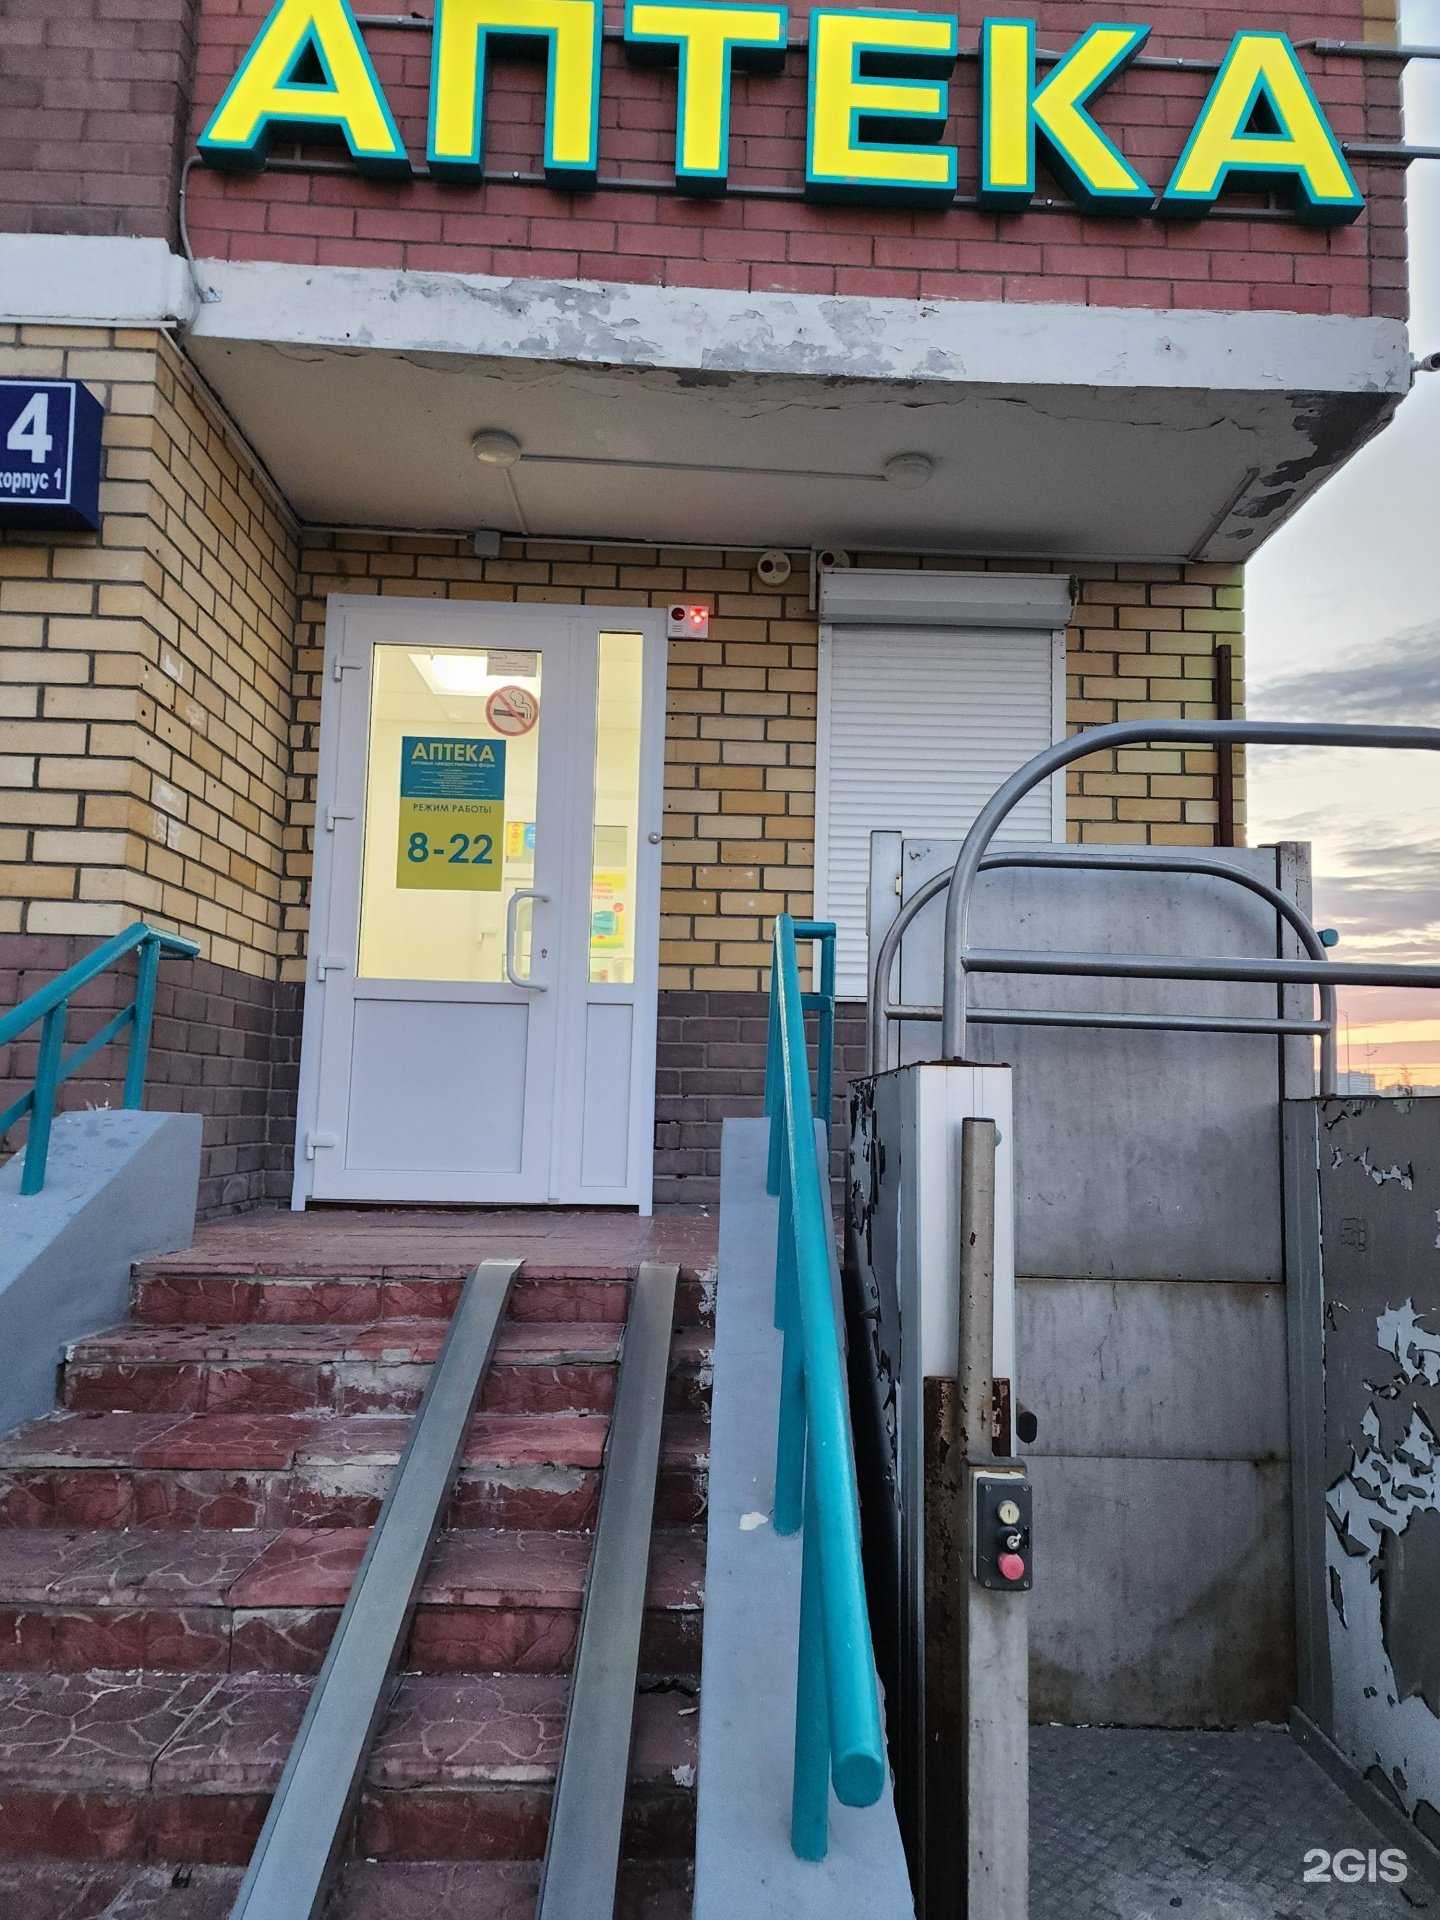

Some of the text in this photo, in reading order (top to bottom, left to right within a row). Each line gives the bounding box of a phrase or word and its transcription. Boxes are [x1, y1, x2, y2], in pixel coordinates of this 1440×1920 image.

[196, 0, 1367, 212] АПТЕКА
[7, 393, 53, 463] 4
[54, 468, 62, 489] 1
[411, 742, 495, 762] АПТЕКА
[413, 803, 492, 814] РЕЖИМ РАБОТЫ
[407, 832, 493, 864] 8-22
